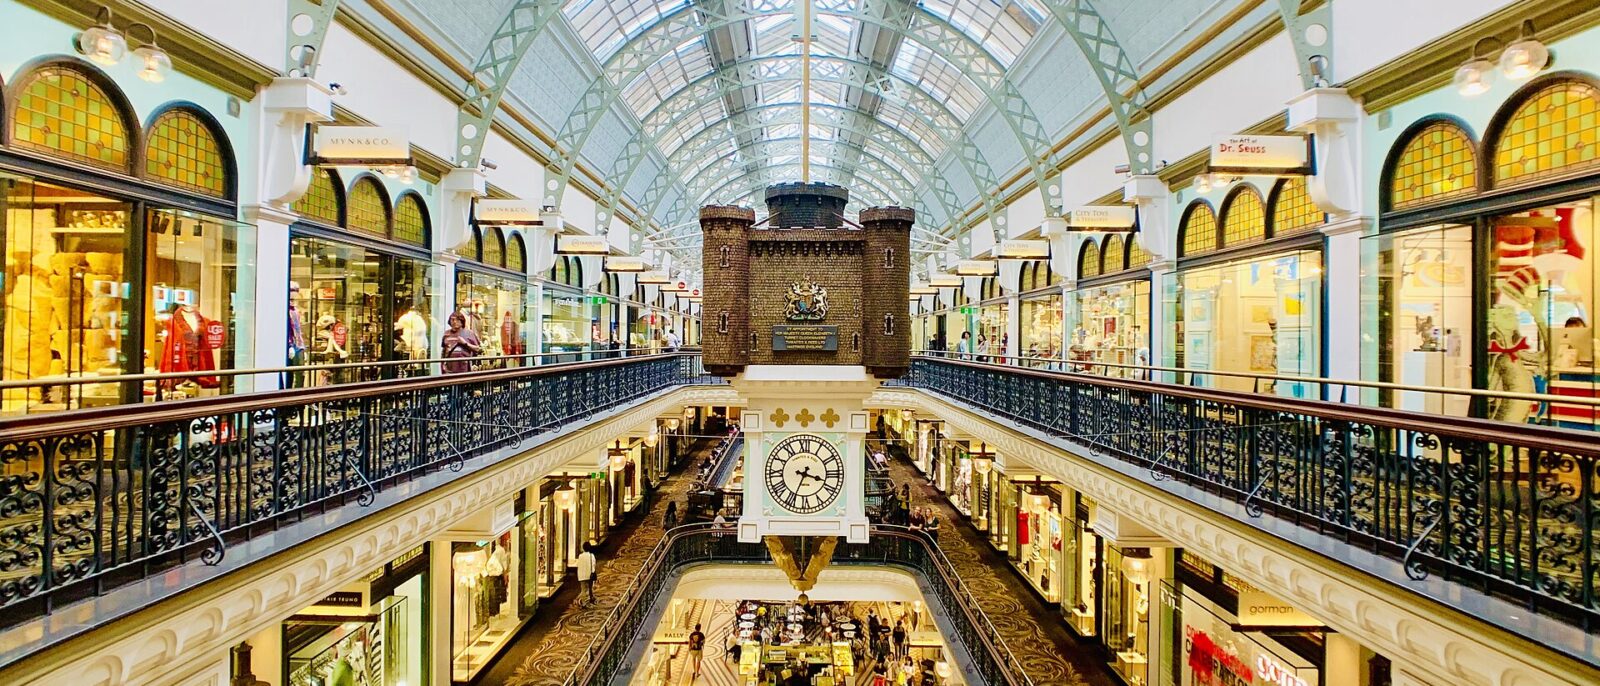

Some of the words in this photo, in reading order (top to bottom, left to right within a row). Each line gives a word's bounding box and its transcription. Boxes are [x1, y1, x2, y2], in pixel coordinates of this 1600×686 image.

[1219, 143, 1235, 152] Dr.
[1238, 143, 1266, 153] Seuss
[1249, 605, 1294, 615] gorman
